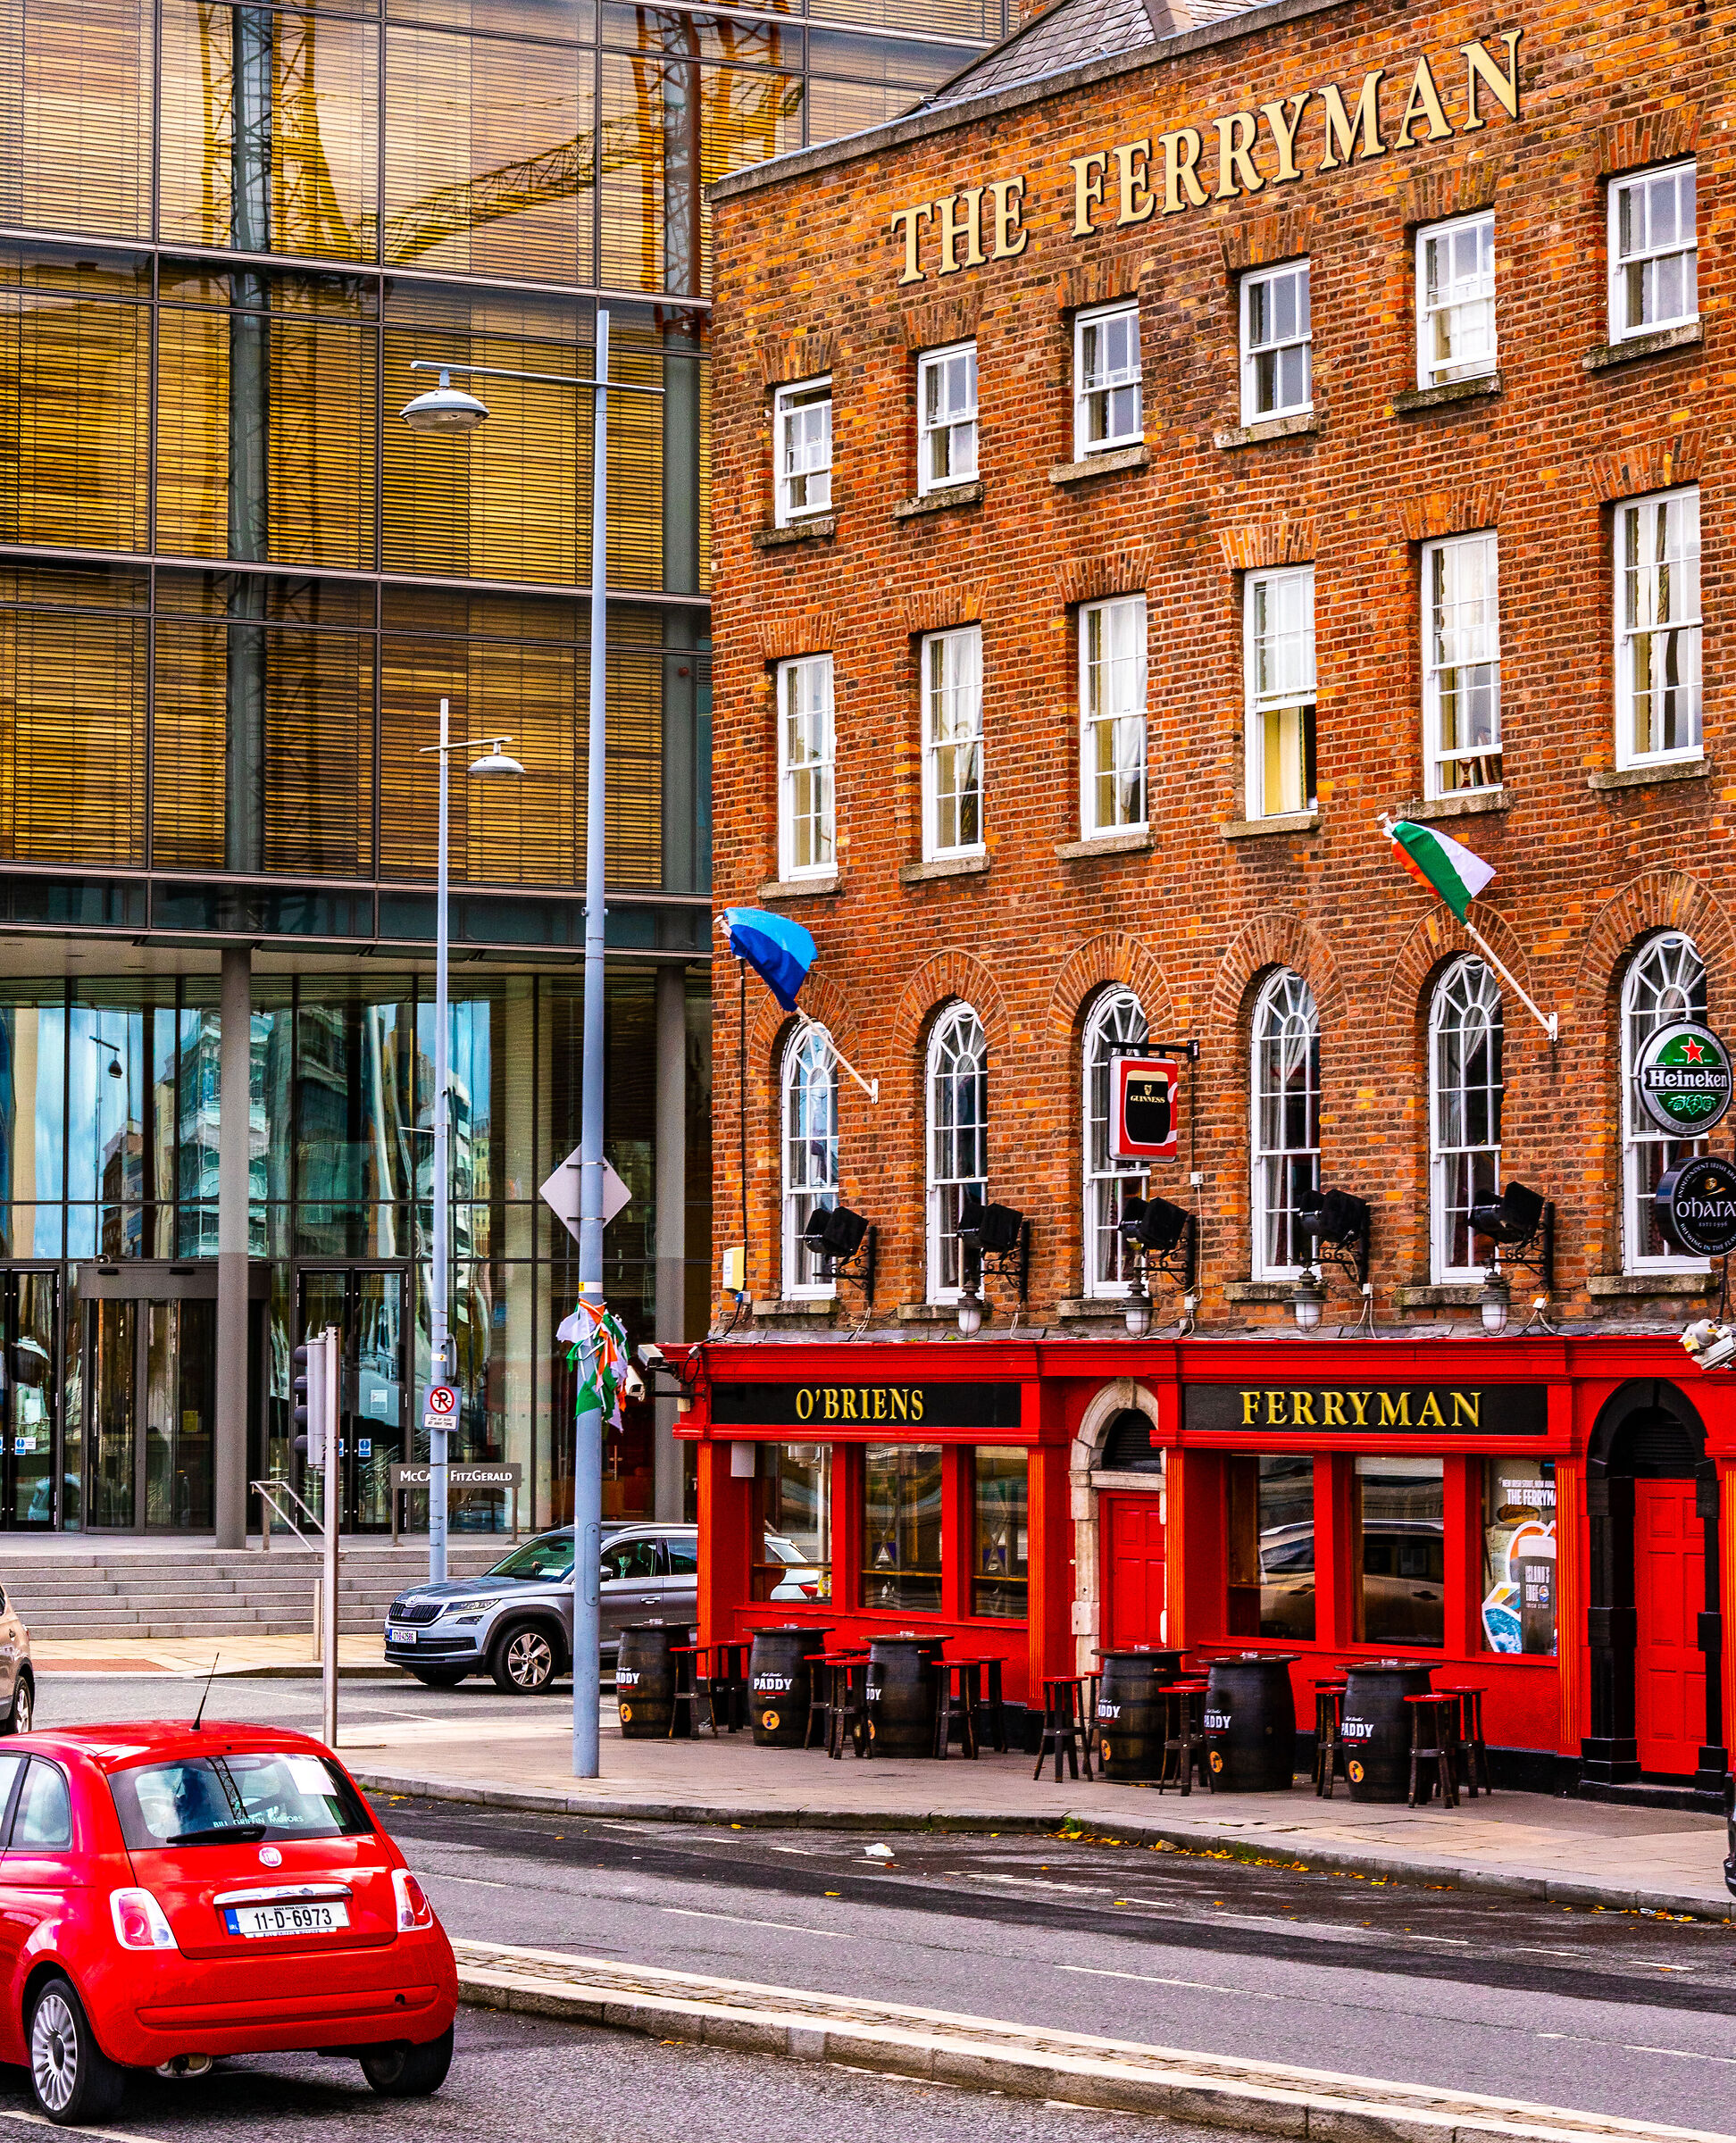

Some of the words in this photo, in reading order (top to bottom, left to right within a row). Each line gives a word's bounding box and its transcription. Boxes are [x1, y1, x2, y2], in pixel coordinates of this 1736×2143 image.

[890, 175, 1028, 285] THE
[1069, 29, 1522, 238] FERRYMAN
[1648, 1069, 1728, 1088] Heineken
[1130, 1095, 1166, 1104] GUINNESS
[795, 1388, 924, 1421] O'BRIENS
[1239, 1390, 1482, 1427] FERRYMAN
[1506, 1488, 1523, 1505] THE
[753, 1678, 793, 1690] PADDY
[213, 1821, 228, 1829] BILL
[269, 1815, 305, 1823] MOTORS
[254, 1908, 332, 1930] 11-D-6973
